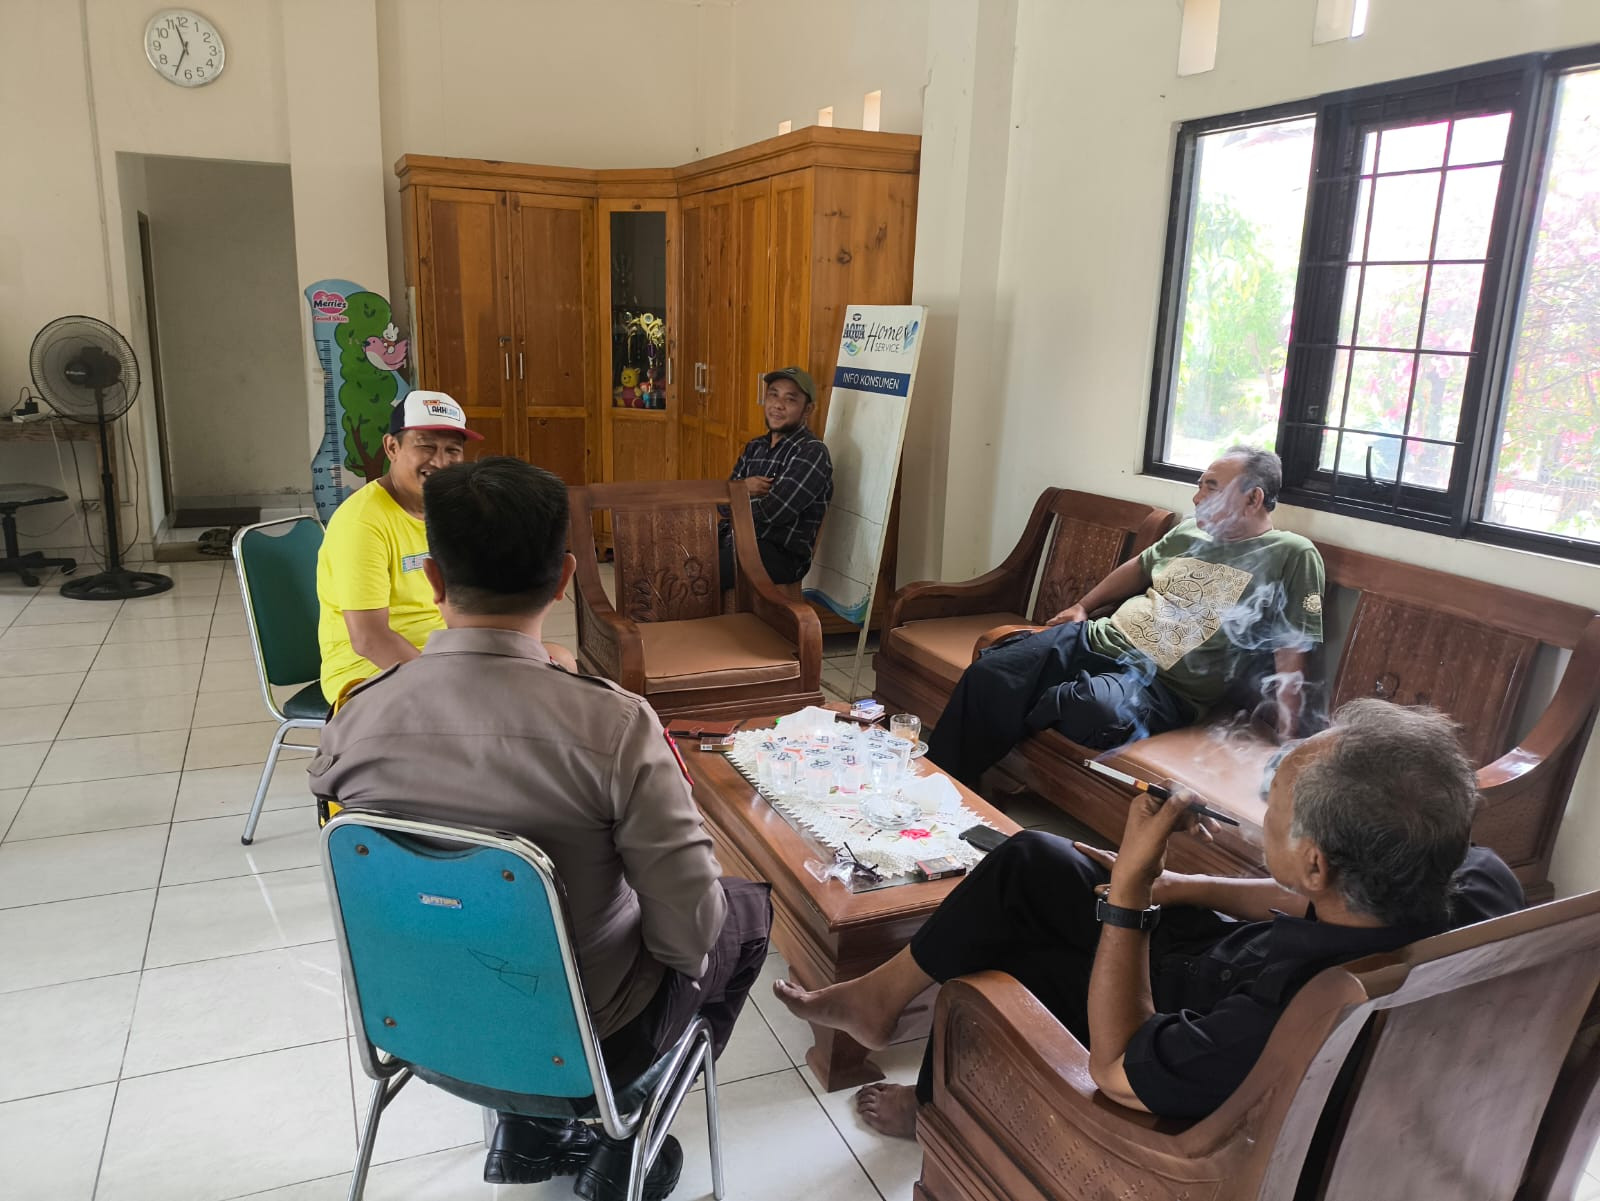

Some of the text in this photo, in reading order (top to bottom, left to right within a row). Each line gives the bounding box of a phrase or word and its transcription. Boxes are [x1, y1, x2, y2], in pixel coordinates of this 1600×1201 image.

[165, 18, 175, 30] 11
[176, 16, 189, 28] 12
[194, 21, 199, 33] 1
[156, 27, 169, 39] 10
[202, 31, 211, 43] 2
[152, 40, 161, 51] 9
[209, 45, 217, 56] 3
[159, 54, 168, 65] 8
[206, 58, 214, 68] 4
[184, 69, 193, 80] 6
[196, 66, 205, 77] 5
[313, 299, 347, 309] Merries
[843, 321, 904, 352] AQUA Home
[875, 342, 901, 353] SERVICE
[843, 372, 900, 390] INFO KONSUMEN
